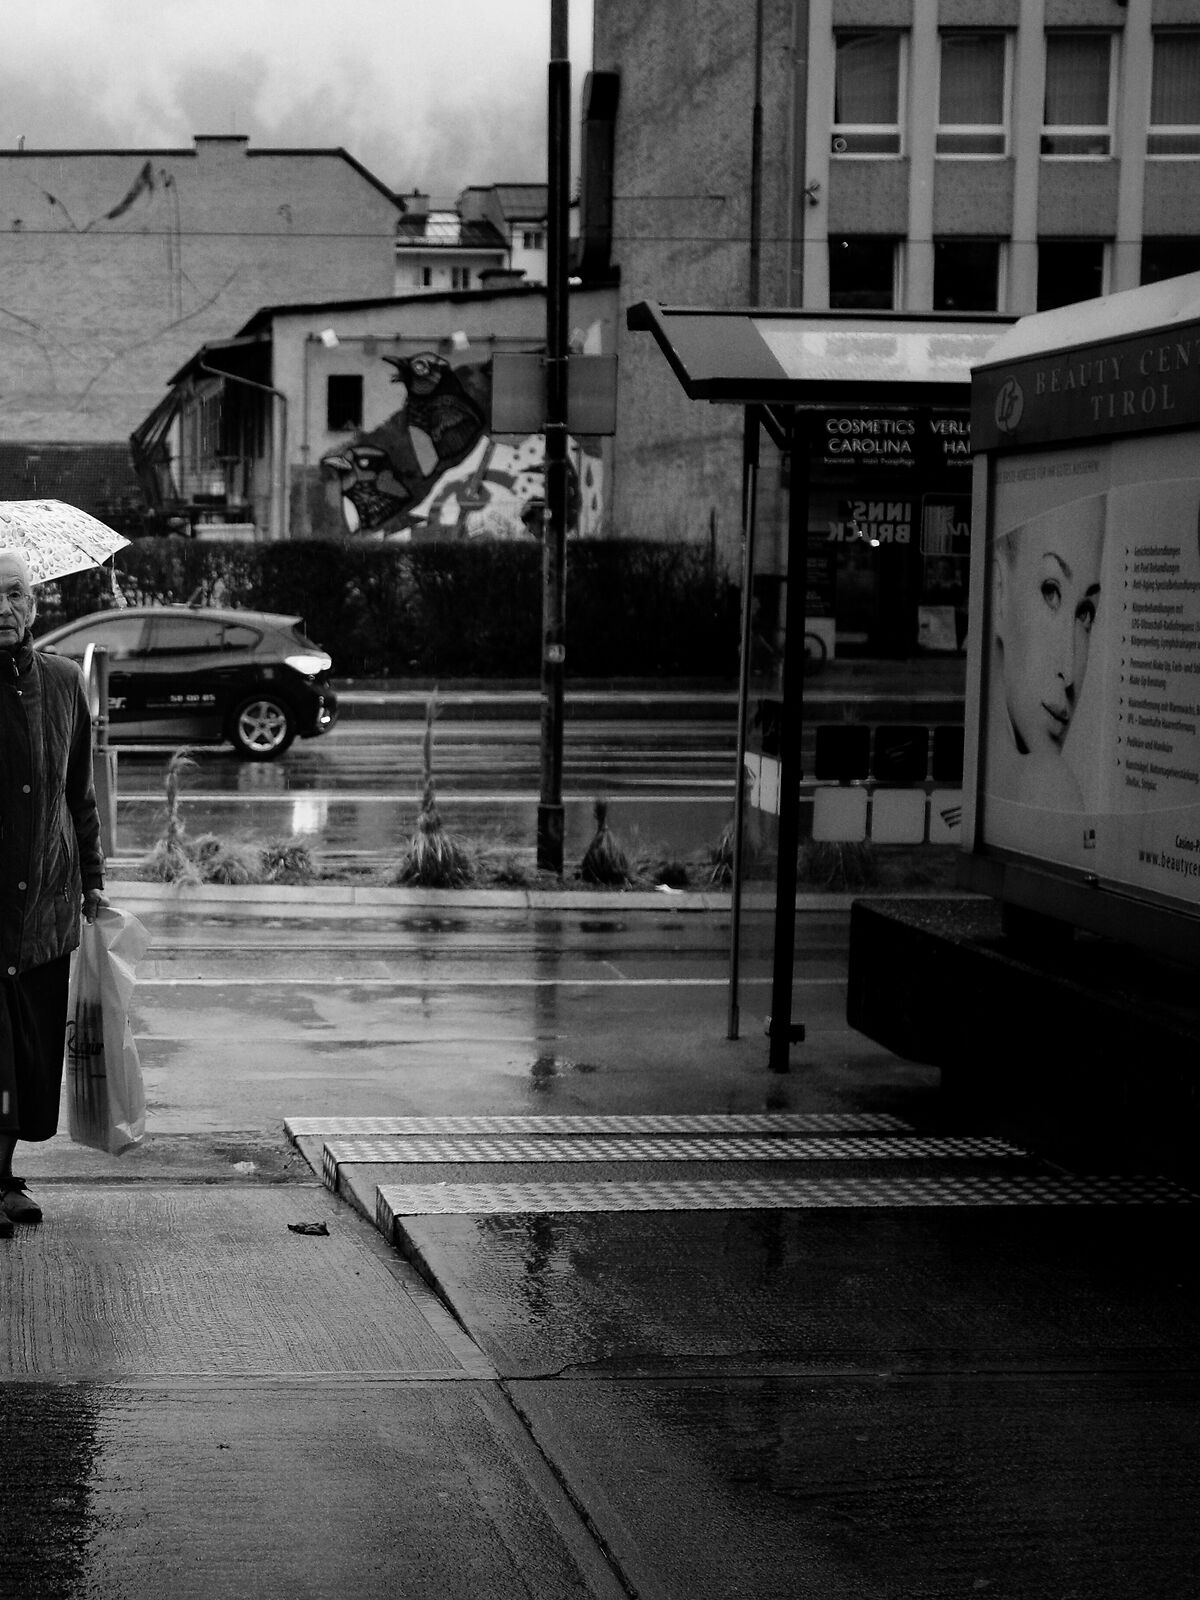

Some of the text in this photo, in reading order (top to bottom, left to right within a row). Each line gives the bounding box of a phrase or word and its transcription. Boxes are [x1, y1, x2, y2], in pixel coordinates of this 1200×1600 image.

[1036, 339, 1200, 396] BEAUTY CEN
[1090, 383, 1176, 421] TIROL
[825, 418, 916, 436] COSMETICS
[827, 437, 913, 454] CAROLINA
